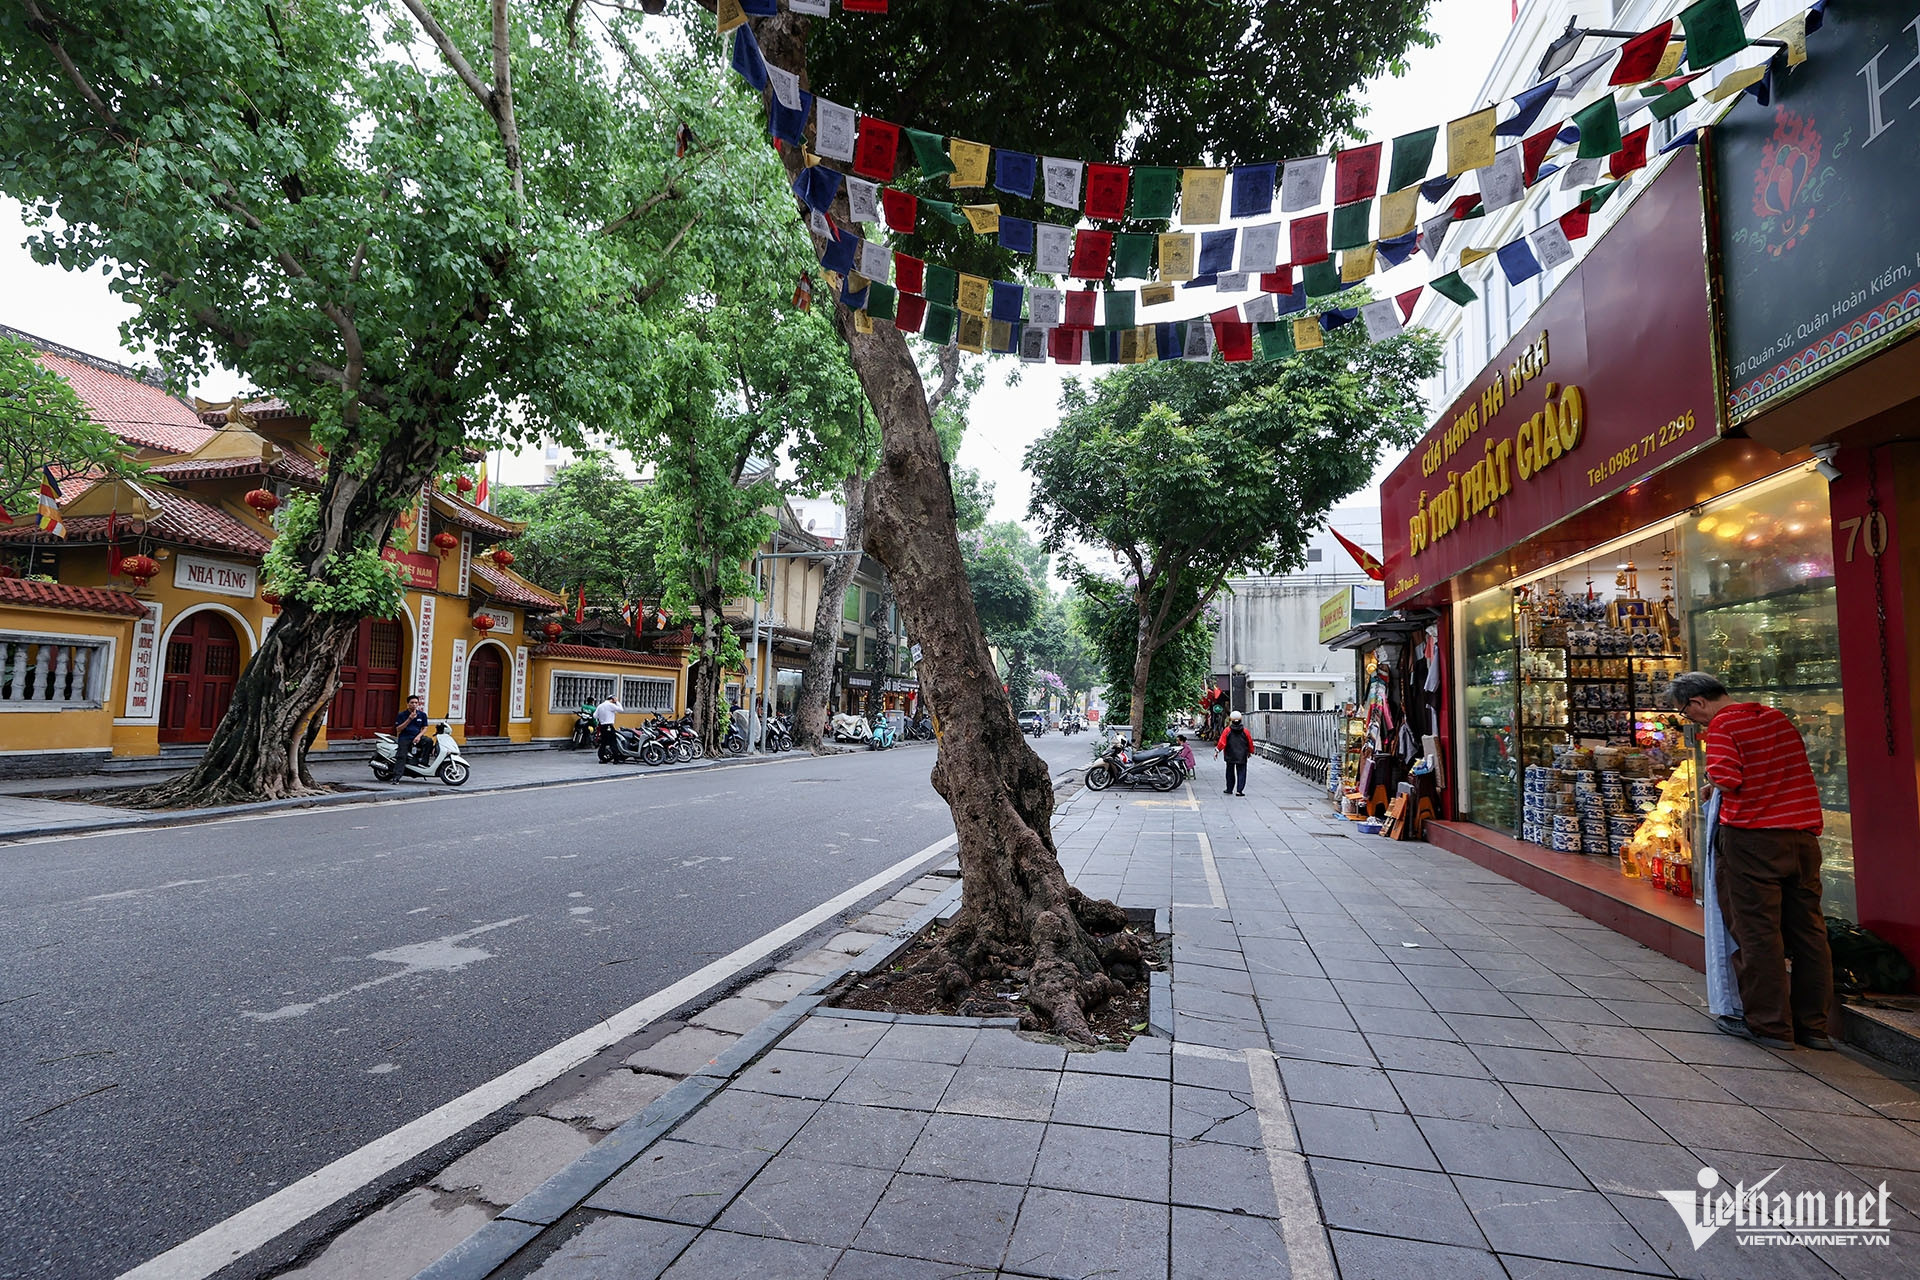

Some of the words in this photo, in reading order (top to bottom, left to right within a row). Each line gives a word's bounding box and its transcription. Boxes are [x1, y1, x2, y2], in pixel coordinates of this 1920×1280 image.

[1734, 362, 1746, 379] 70
[1797, 313, 1829, 339] Quận
[1832, 289, 1866, 318] Hoàn
[1444, 402, 1478, 462] HÀNG
[1640, 432, 1656, 457] 71
[1658, 409, 1695, 448] 2296
[1429, 471, 1460, 543] THỜ
[1461, 438, 1513, 521] PHẬT
[1516, 382, 1584, 482] GIÁO
[1840, 511, 1888, 562] 70
